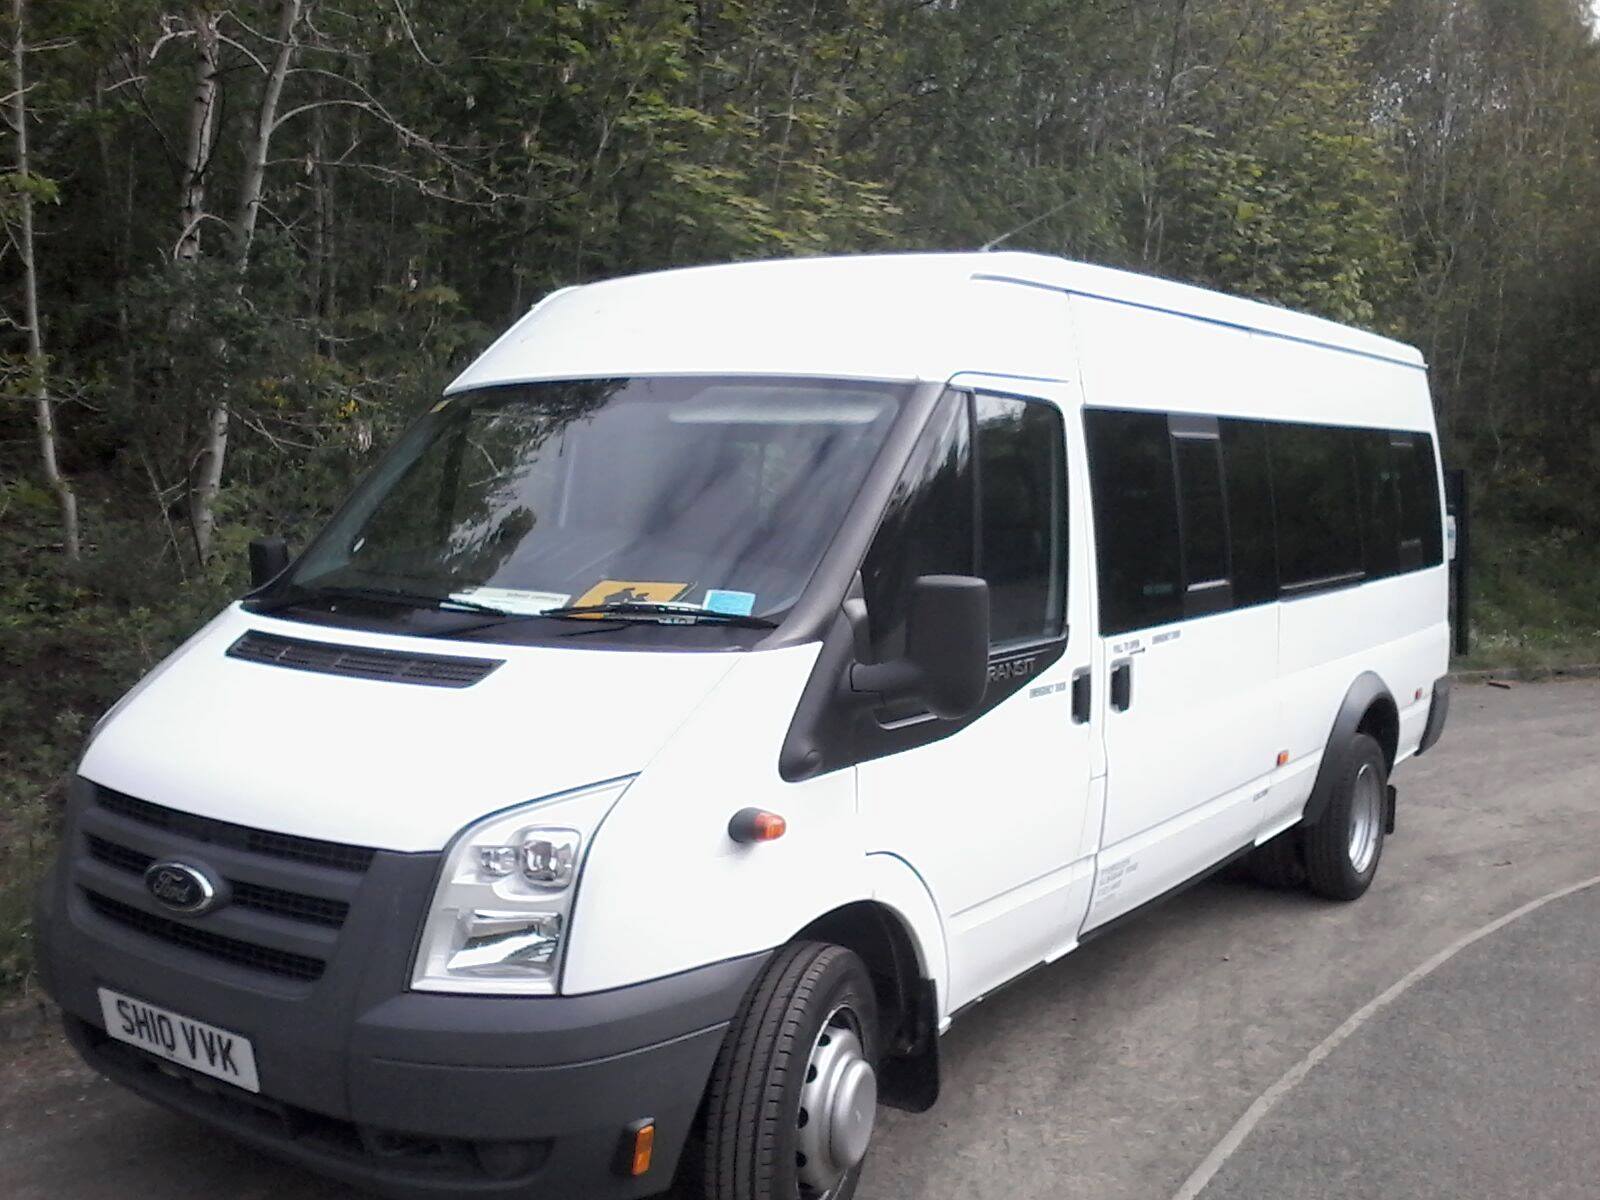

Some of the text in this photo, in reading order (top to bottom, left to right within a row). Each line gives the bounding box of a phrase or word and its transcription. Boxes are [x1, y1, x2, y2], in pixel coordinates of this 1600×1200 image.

[986, 657, 1036, 682] RANSIT
[152, 870, 193, 904] Ford
[116, 999, 239, 1076] SH10 VVK
